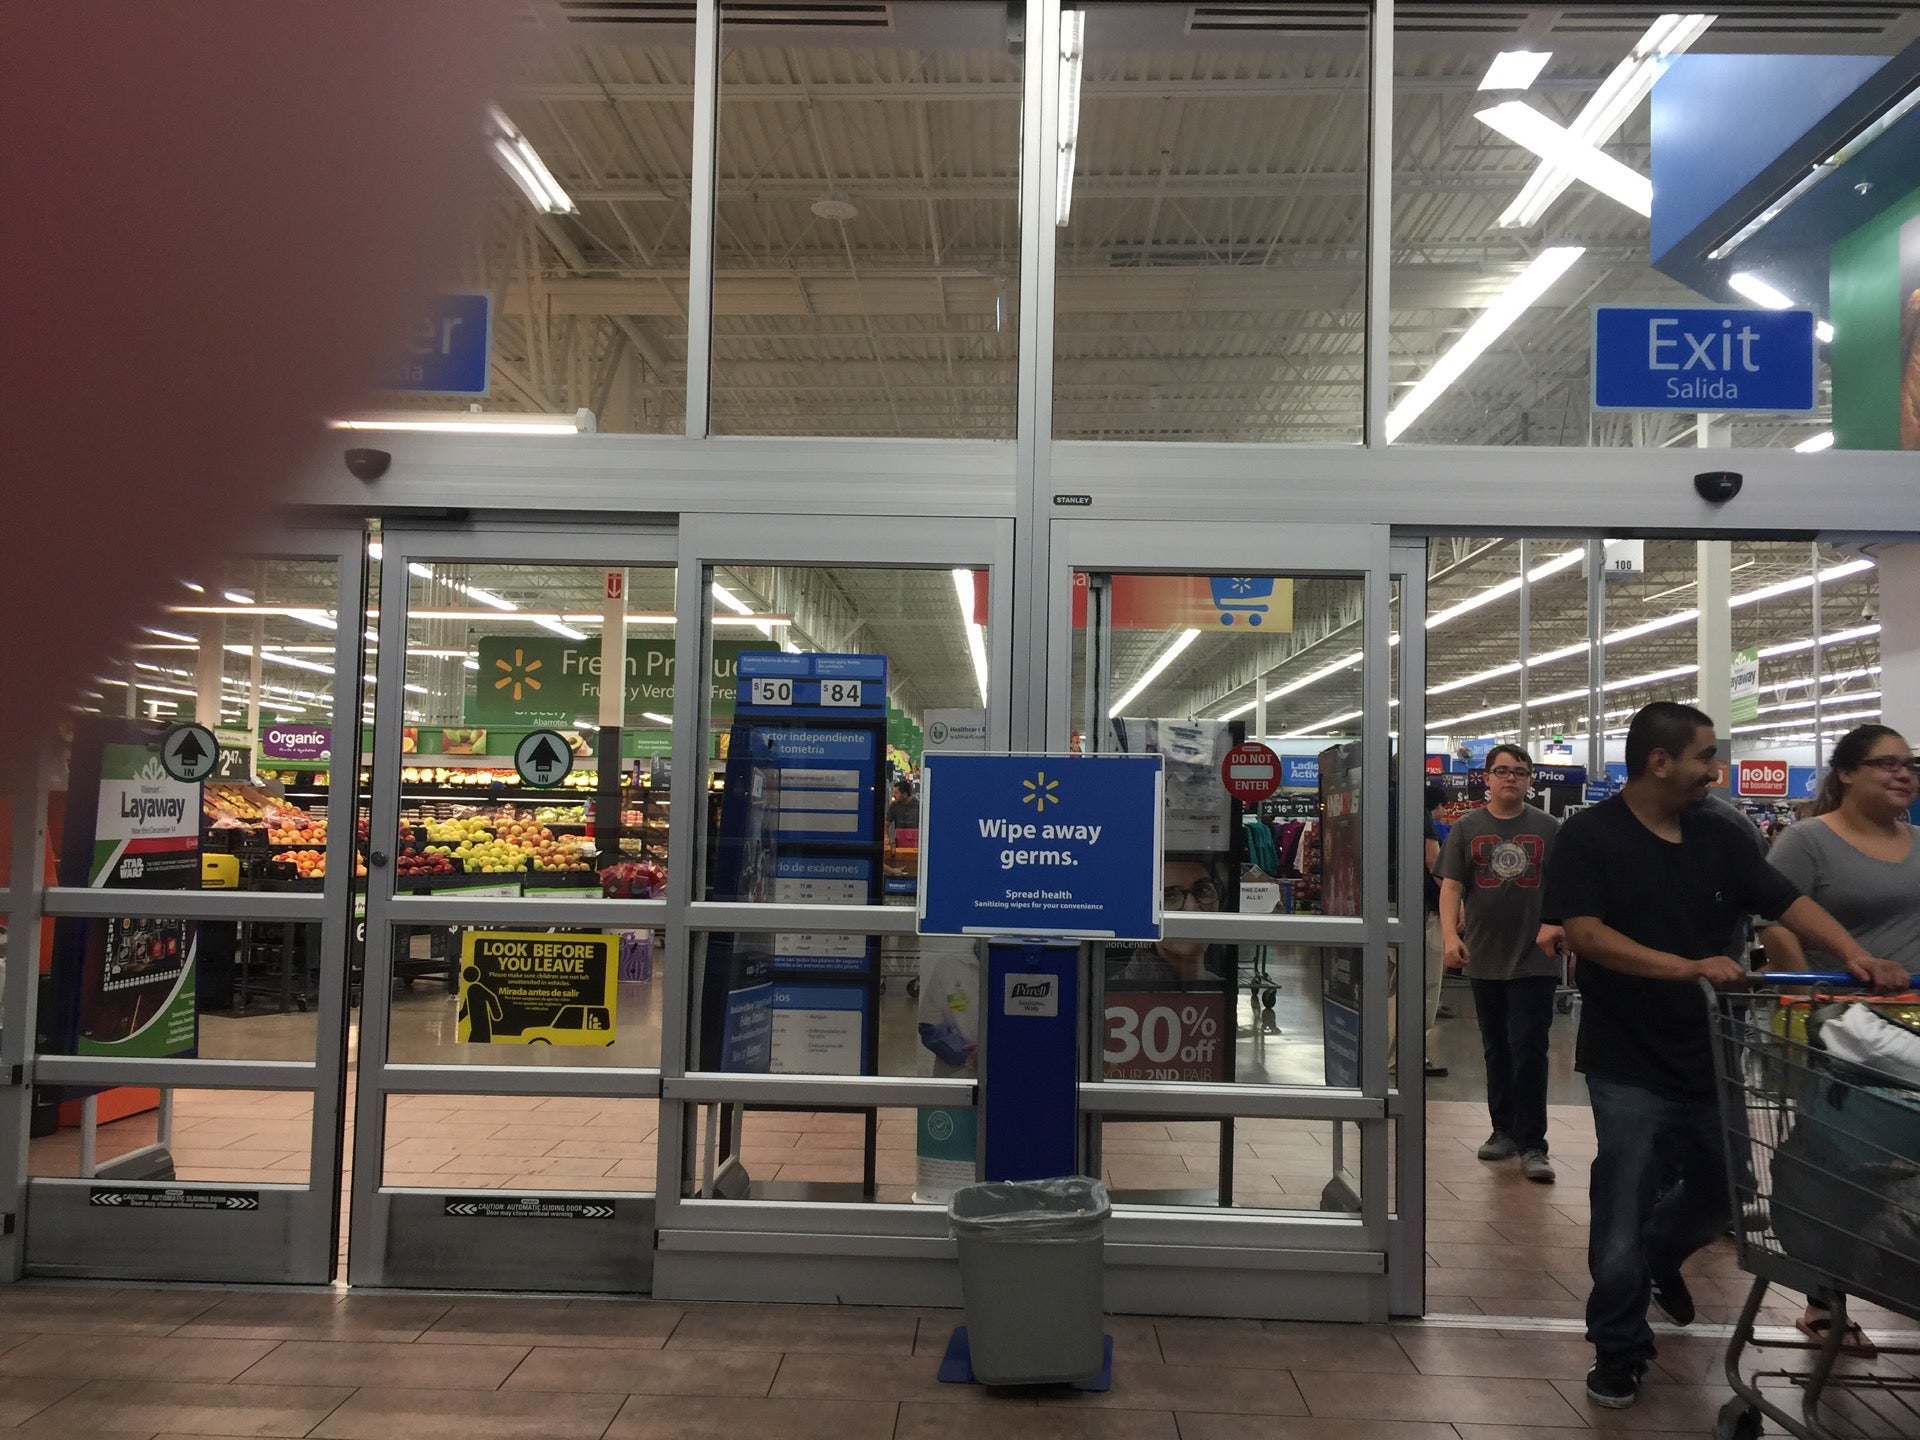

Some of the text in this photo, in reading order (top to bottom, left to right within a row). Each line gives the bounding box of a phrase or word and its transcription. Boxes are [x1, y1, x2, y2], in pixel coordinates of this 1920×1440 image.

[1648, 318, 1760, 372] Exit
[1666, 377, 1738, 399] Salida
[1056, 496, 1089, 504] STANLEY
[1615, 560, 1632, 570] 100
[1731, 670, 1756, 690] ayaway
[630, 687, 640, 701] y
[533, 719, 568, 727] Abarrotes
[269, 730, 325, 748] Organic
[790, 731, 865, 744] independiente
[1231, 754, 1272, 764] DO NOT
[1291, 761, 1319, 770] Ladie
[184, 768, 195, 777] IN
[1291, 769, 1319, 779] Activ
[1539, 772, 1565, 781] Price
[1742, 766, 1785, 782] nobo
[538, 774, 549, 783] IN
[1235, 781, 1269, 791] ENTER
[120, 791, 186, 825] Layaway
[978, 819, 1102, 845] Wipe away
[120, 858, 144, 868] STAR
[1000, 849, 1079, 869] germs.
[792, 862, 805, 872] de
[120, 868, 143, 879] WARS
[1005, 889, 1073, 900] Spread health
[974, 900, 1009, 909] Sanitizing
[1043, 902, 1060, 910] your
[483, 942, 595, 959] LOOK BEFORE
[497, 957, 585, 973] YOU LEAVE
[498, 987, 580, 998] Mirada antes de salir
[1015, 984, 1047, 996] Purell
[1181, 1039, 1217, 1063] off
[1103, 1069, 1212, 1080] YOUR 2ND PAIR
